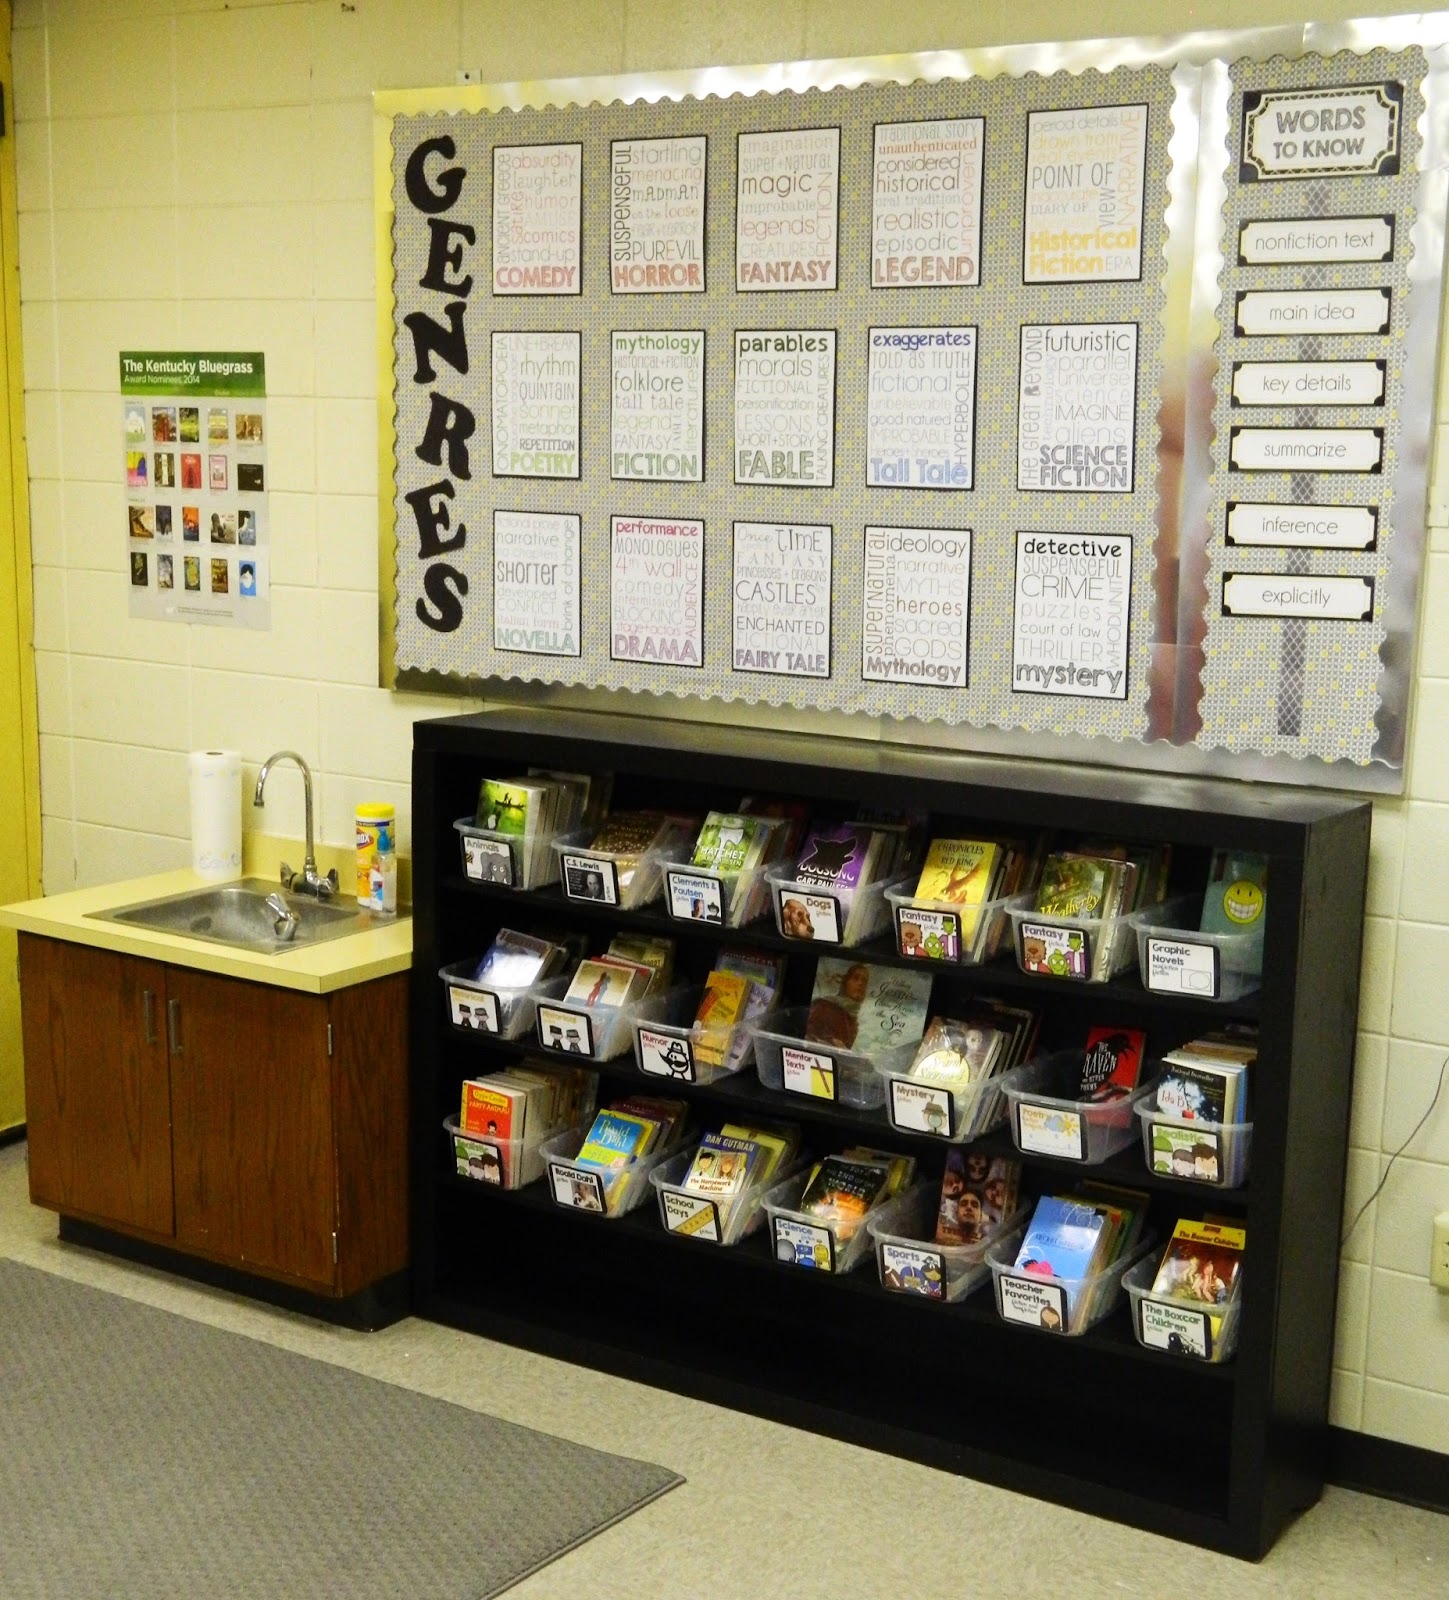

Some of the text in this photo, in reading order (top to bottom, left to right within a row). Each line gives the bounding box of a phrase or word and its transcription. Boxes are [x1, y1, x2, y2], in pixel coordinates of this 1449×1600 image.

[1276, 106, 1366, 134] WORDS
[632, 141, 702, 166] startling
[878, 138, 978, 155] unauthenticated
[1273, 138, 1366, 160] TO KNOW
[511, 149, 577, 170] absurdity
[513, 169, 576, 195] laughter
[632, 168, 702, 186] menacing
[742, 171, 813, 199] magic
[875, 172, 962, 193] historical
[1031, 161, 1115, 190] POINT OF
[525, 195, 578, 209] humor
[741, 215, 816, 241] legends
[876, 207, 960, 232] realistic
[523, 230, 576, 244] comics
[875, 231, 960, 256] episodic
[1030, 226, 1137, 252] Historical
[1256, 231, 1375, 251] nonfiction text
[740, 260, 832, 284] FANTASY
[875, 255, 974, 284] LEGEND
[1030, 252, 1135, 275] Fiction ERA
[496, 265, 577, 289] COMEDY
[613, 263, 702, 288] HORROR
[1269, 302, 1355, 321] main idea
[615, 334, 701, 355] mythology
[738, 333, 829, 358] parables
[872, 331, 972, 351] exaggerates
[1044, 328, 1131, 353] futuristic
[123, 359, 254, 376] The Kentucky Bluegrass
[520, 352, 576, 381] rhythm
[738, 354, 813, 377] morals
[1058, 350, 1131, 372] parallel
[403, 134, 476, 633] GENRES
[614, 370, 684, 392] folklore
[871, 370, 953, 393] fictional
[1262, 374, 1352, 394] key details
[519, 403, 578, 420] sonnet
[615, 393, 684, 411] tall tale
[1054, 403, 1131, 422] IMAGINE
[614, 408, 672, 434] legend
[737, 414, 813, 433] LESSONS
[870, 411, 904, 428] good
[953, 370, 970, 465] HYPERBOLE
[614, 434, 671, 451] FANTASY
[1055, 420, 1126, 445] aliens
[519, 438, 575, 451] REPETITION
[1263, 442, 1348, 459] summarize
[510, 452, 576, 474] POETRY
[613, 452, 698, 478] FICTION
[738, 450, 815, 480] FABLE
[1039, 444, 1129, 468] SCIENCE
[869, 457, 969, 485] Tall Tale
[1039, 465, 1128, 489] FICTION
[615, 520, 699, 538] performance
[1262, 518, 1339, 535] inference
[496, 532, 560, 548] narrative
[885, 531, 967, 559] ideology
[1023, 538, 1122, 558] detective
[897, 559, 965, 575] narrative
[735, 579, 817, 606] CASTLES
[897, 576, 964, 598] MYTHS
[1021, 573, 1105, 601] CRIME
[1262, 586, 1331, 609] explicitly
[684, 562, 698, 640] AUDIENCE
[896, 595, 963, 617] heroes
[1020, 601, 1102, 622] puzzles
[736, 615, 826, 637] ENCHANTED
[894, 616, 963, 638] sacred
[1020, 623, 1055, 635] court
[1078, 623, 1101, 638] law
[496, 627, 577, 654] NOVELLA
[614, 633, 699, 663] DRAMA
[894, 636, 963, 661] GODS
[1018, 637, 1103, 663] THRILLER
[735, 648, 827, 674] FAIRY TALE
[866, 655, 962, 684] Mythology
[1016, 661, 1123, 695] mystery
[466, 839, 500, 853] Animals
[581, 860, 601, 872] Lewis
[672, 875, 710, 890] Clements
[672, 886, 704, 900] Paulsen
[807, 896, 832, 911] Dogs
[900, 908, 938, 926] Fantasy
[1023, 924, 1064, 942] Fantasy
[1152, 943, 1191, 957] Graphic
[1152, 953, 1185, 967] Novels
[642, 1032, 669, 1047] Humor
[785, 1049, 813, 1063] Mentor
[785, 1059, 806, 1071] Texts
[1082, 1050, 1118, 1078] RAVEN
[896, 1083, 936, 1101] Mystery
[705, 1134, 756, 1153] DAN GUTMAN
[576, 1171, 594, 1184] Dahl
[665, 1195, 695, 1210] School
[666, 1204, 690, 1219] Days
[777, 1218, 813, 1235] Science
[887, 1247, 921, 1263] Sports
[1004, 1278, 1045, 1295] Teacher
[1004, 1288, 1052, 1306] Favorites
[1145, 1303, 1201, 1325] The Boxcar
[1145, 1314, 1188, 1333] Children
